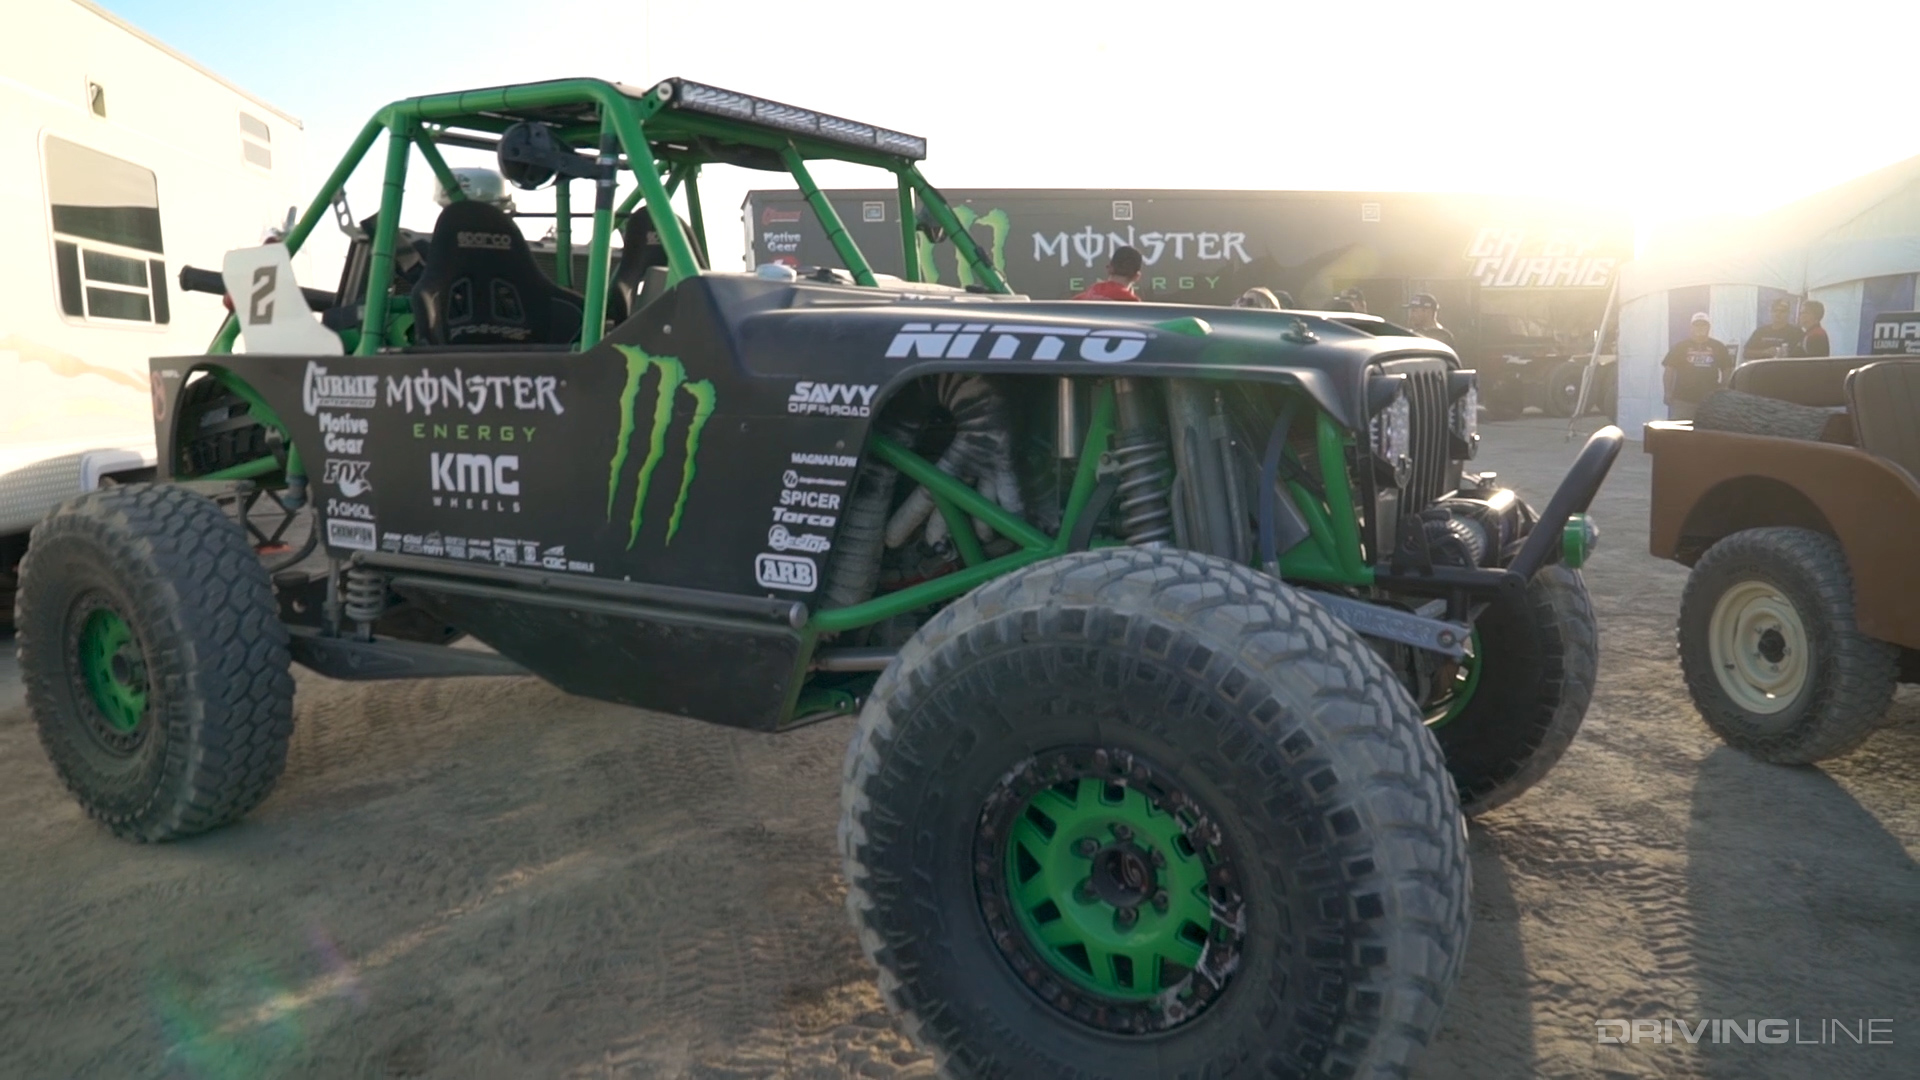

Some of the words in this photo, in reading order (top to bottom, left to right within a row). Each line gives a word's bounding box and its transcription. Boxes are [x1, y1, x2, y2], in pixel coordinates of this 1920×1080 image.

[1032, 225, 1252, 268] MONSTER
[249, 265, 277, 325] 2
[1069, 276, 1220, 290] ERGY
[885, 323, 1147, 362] NITTO
[303, 360, 379, 416] CURRIE
[386, 367, 565, 415] MONSTER
[788, 381, 880, 405] SAVVY
[319, 412, 369, 434] Motive
[413, 423, 537, 442] ENERGY
[324, 432, 364, 455] Gear
[323, 458, 372, 486] FOX
[430, 452, 520, 496] KMC
[433, 497, 521, 513] WHEELS
[779, 489, 841, 510] SPICER
[772, 506, 837, 528] Torco
[763, 559, 812, 586] ARB
